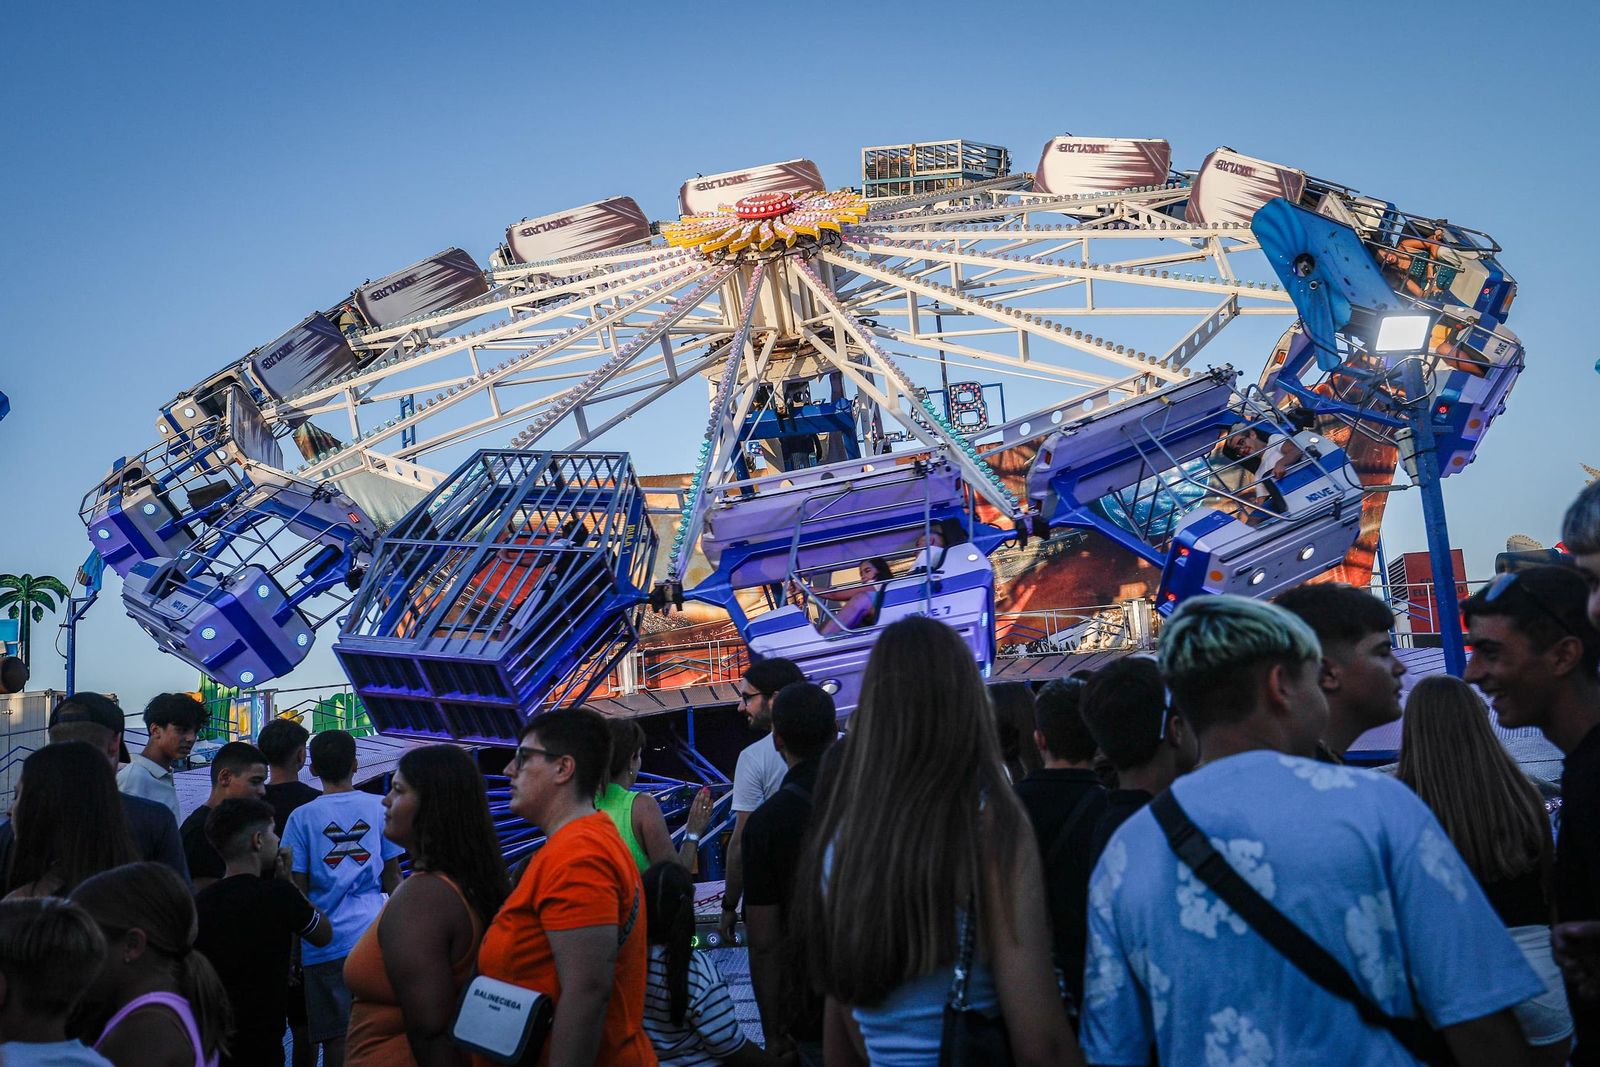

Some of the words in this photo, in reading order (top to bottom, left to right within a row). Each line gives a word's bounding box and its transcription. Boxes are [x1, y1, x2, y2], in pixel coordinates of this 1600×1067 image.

[1056, 143, 1107, 154] SKYLAB
[1215, 159, 1257, 178] SKYLAB
[695, 174, 749, 191] SKYLAB
[518, 215, 574, 237] SKYLAB
[943, 605, 951, 615] 7
